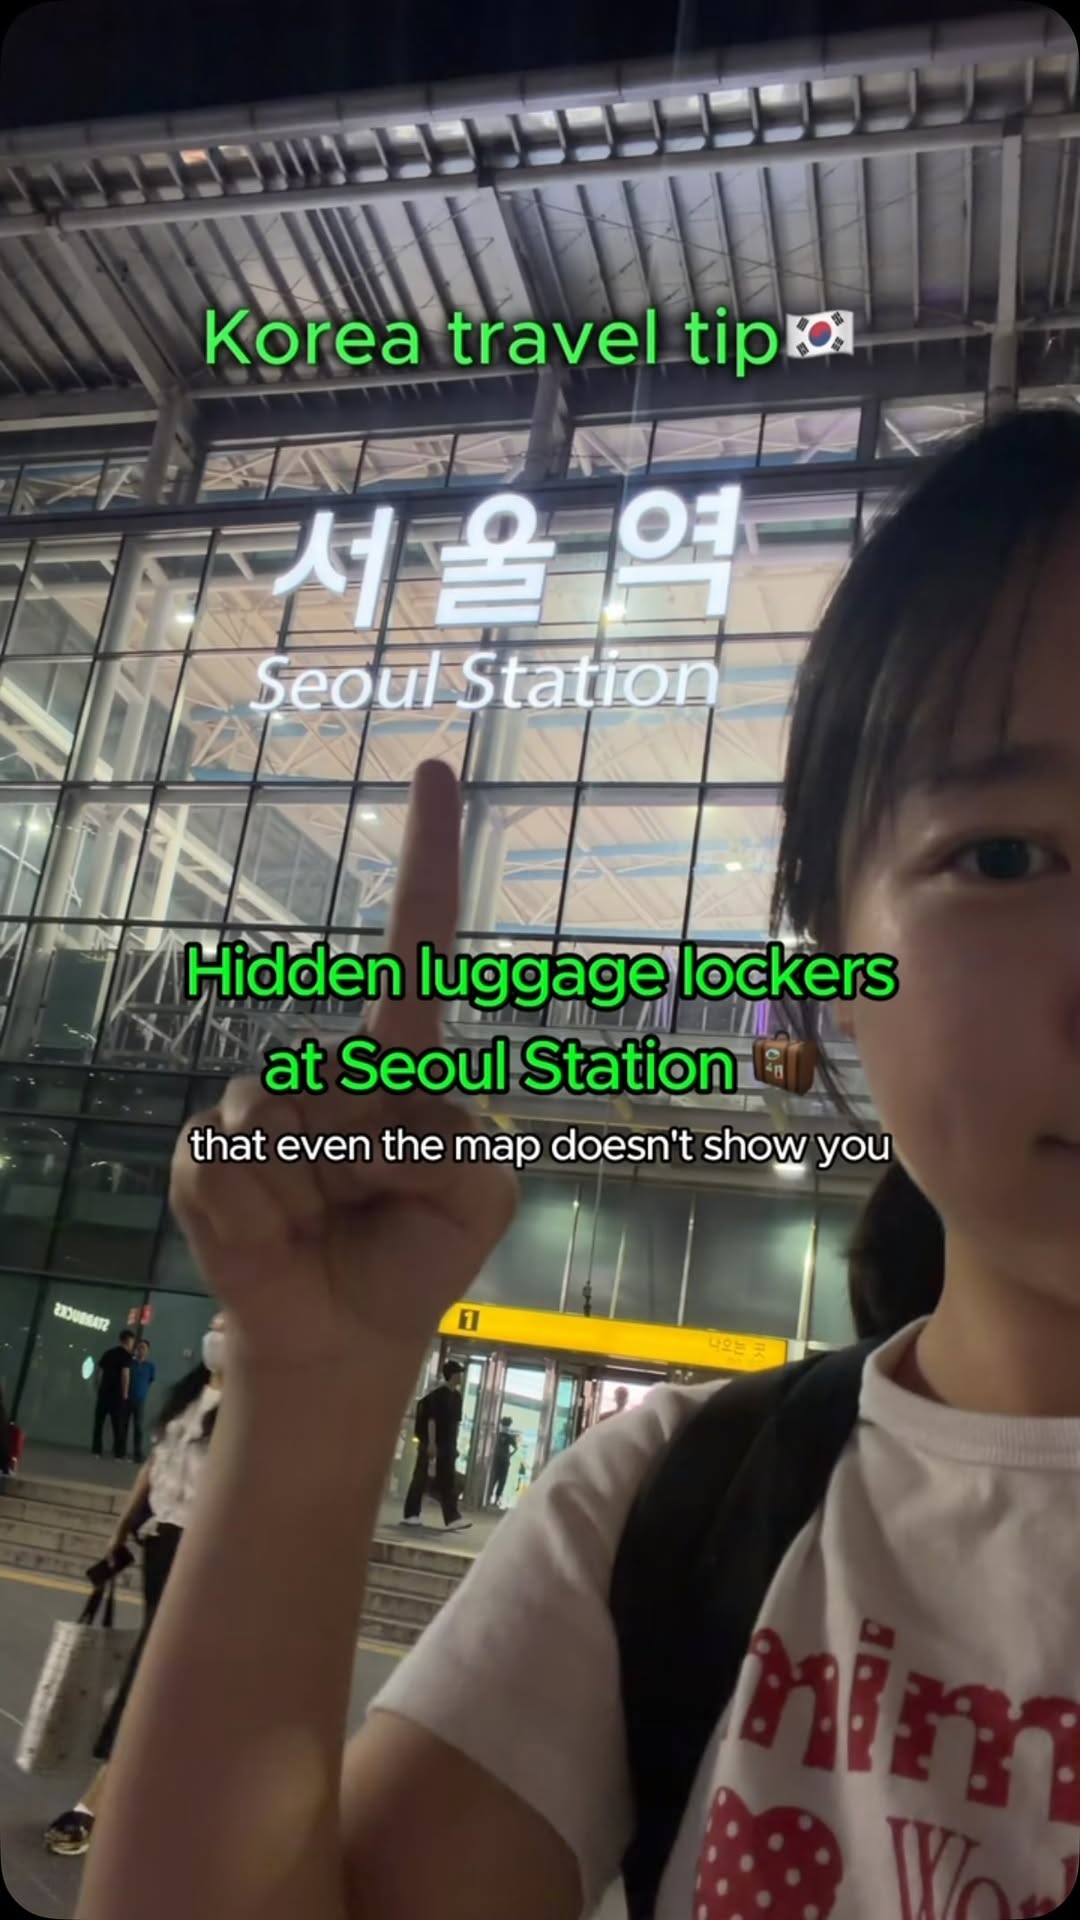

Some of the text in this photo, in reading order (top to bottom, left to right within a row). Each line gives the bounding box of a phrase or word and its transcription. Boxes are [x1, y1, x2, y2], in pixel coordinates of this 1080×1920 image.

[272, 482, 742, 631] 서울역
[250, 649, 720, 710] Seoul Station
[707, 1336, 747, 1356] 나오는
